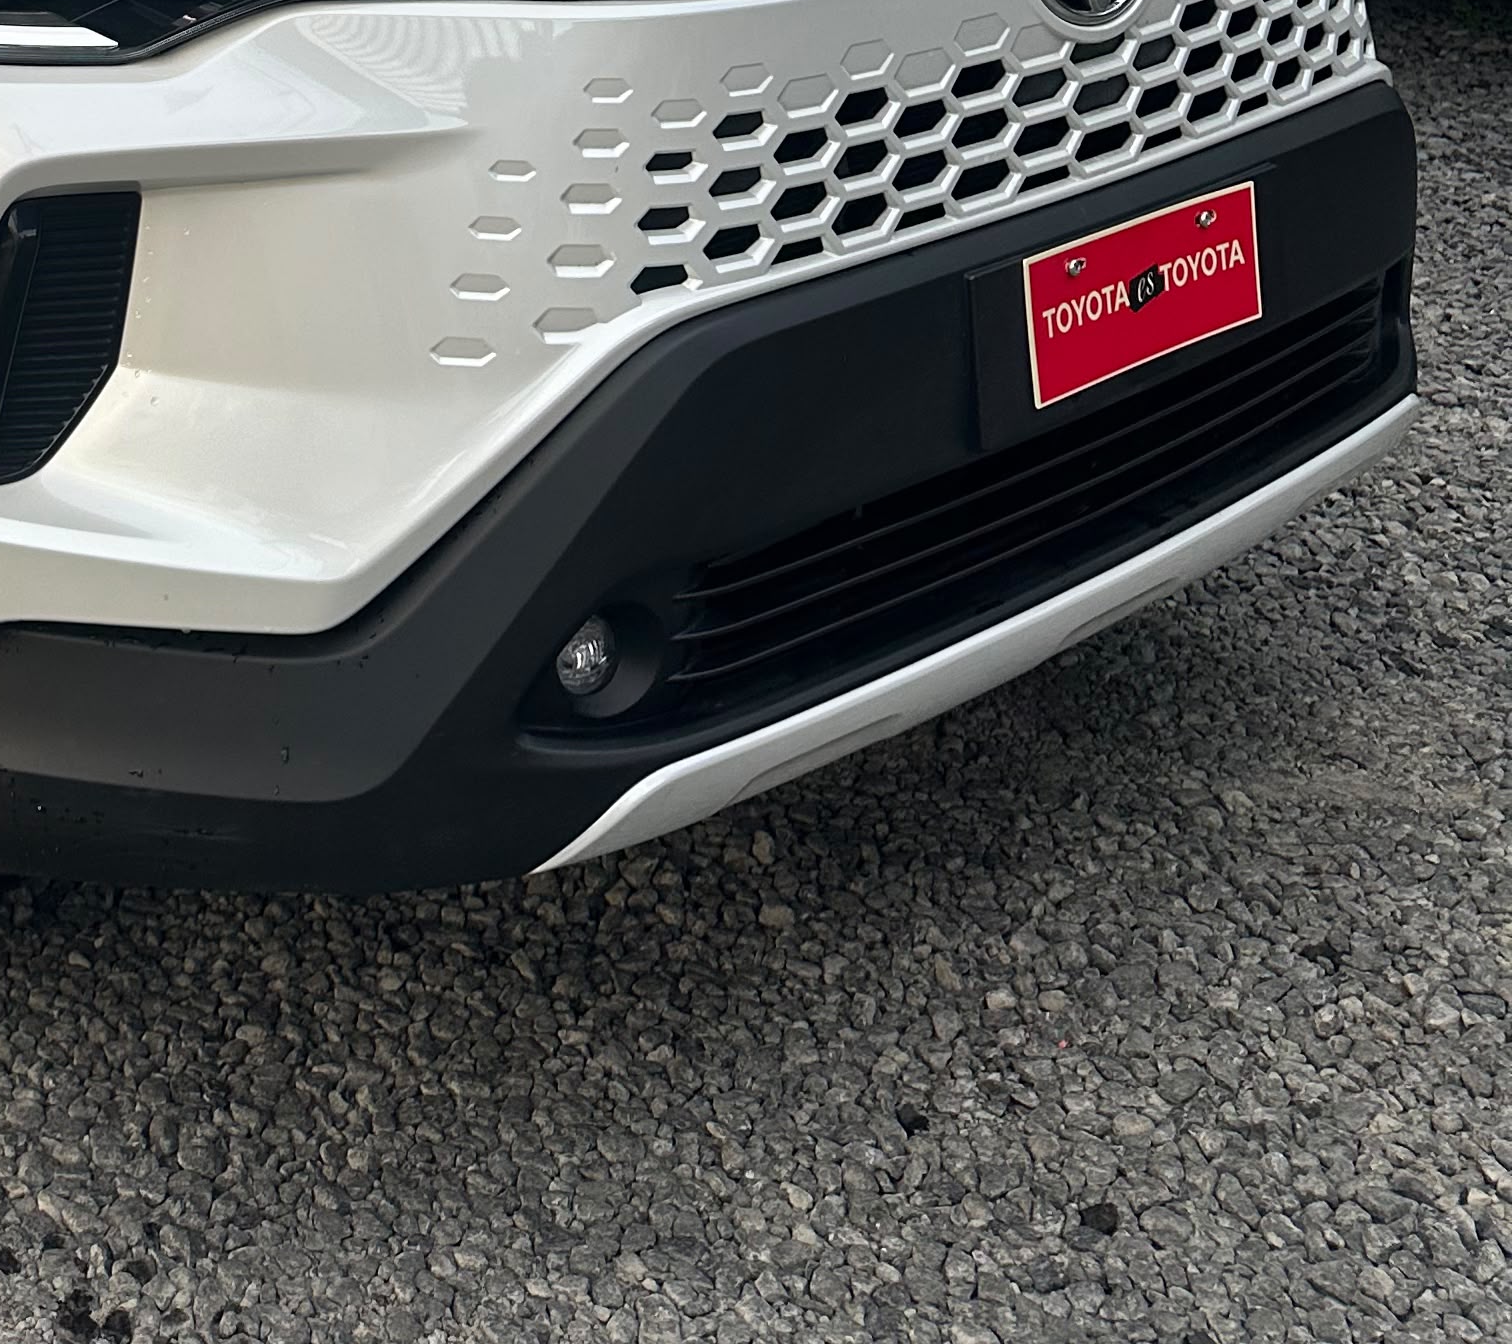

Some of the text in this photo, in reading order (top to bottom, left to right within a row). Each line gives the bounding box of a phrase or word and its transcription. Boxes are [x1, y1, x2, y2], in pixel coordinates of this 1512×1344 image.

[1041, 239, 1246, 339] TOYOTA es TOYOTA
